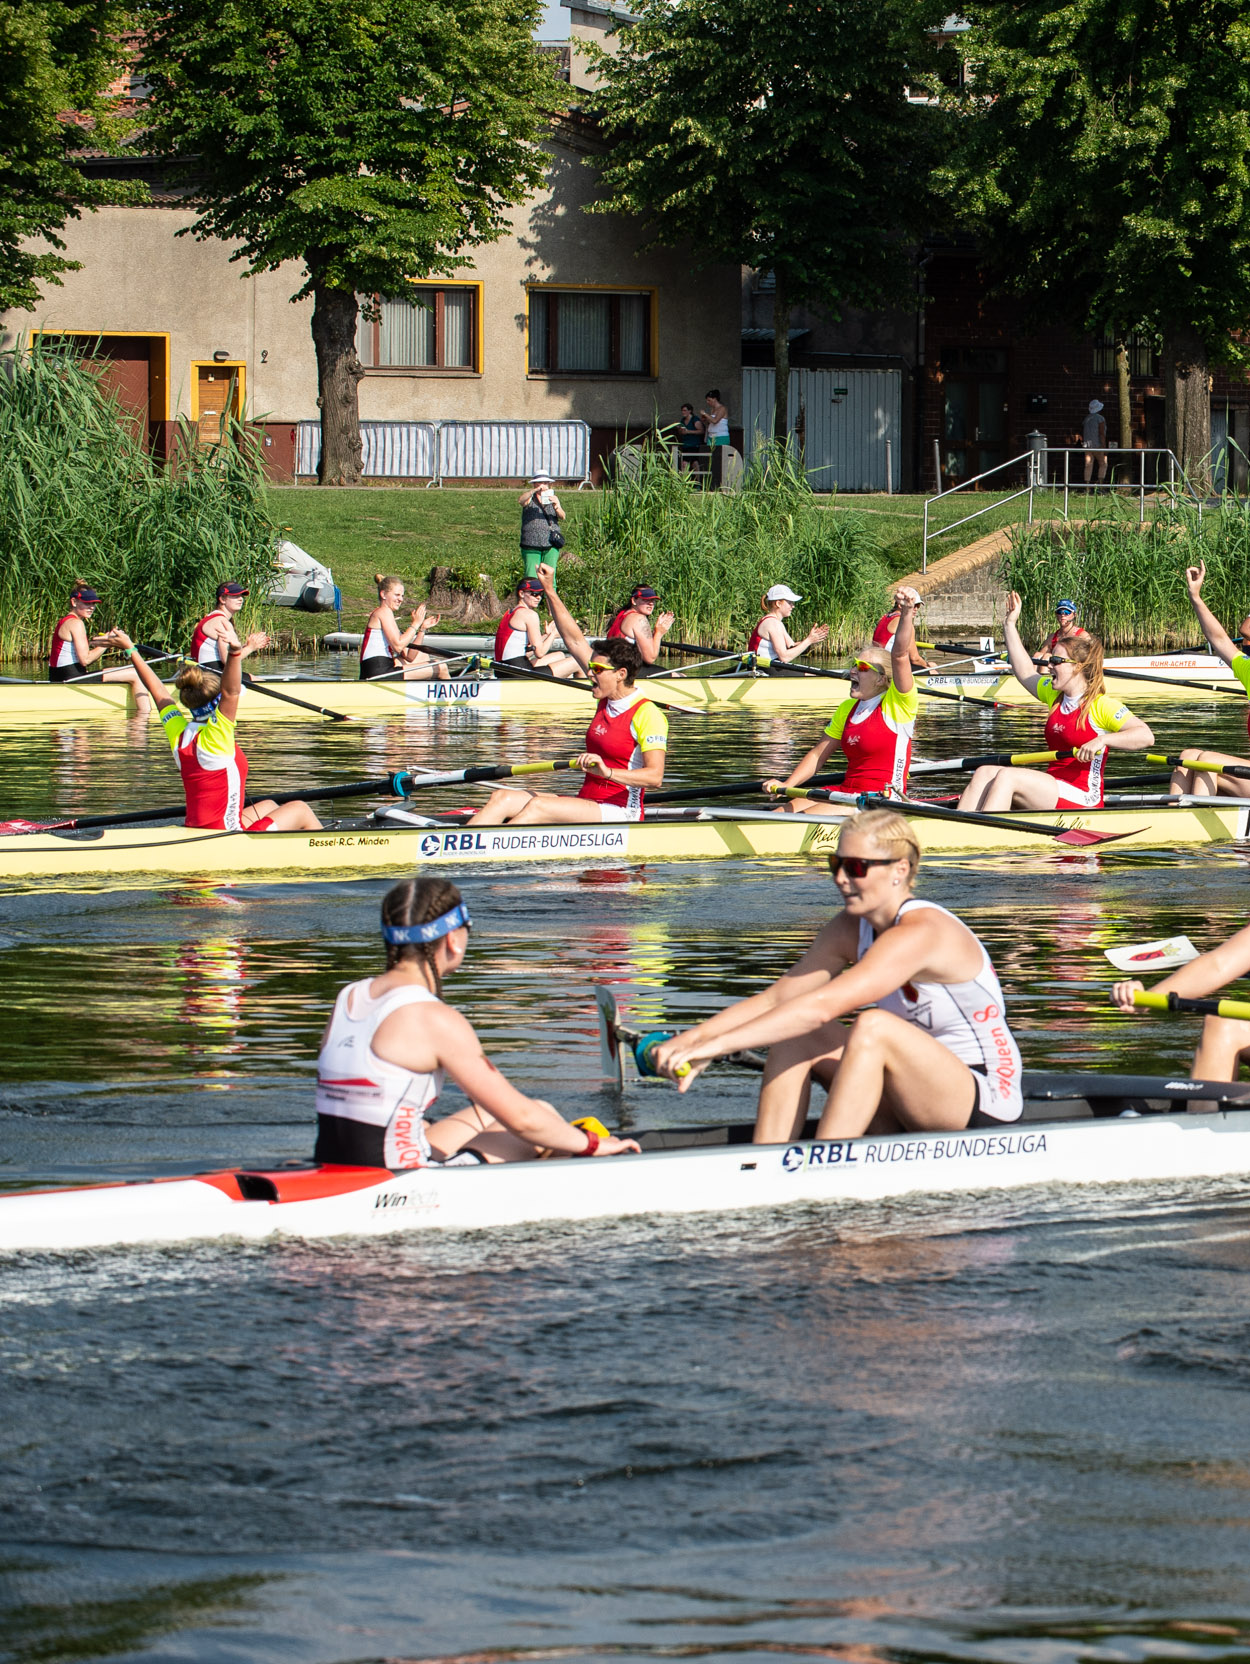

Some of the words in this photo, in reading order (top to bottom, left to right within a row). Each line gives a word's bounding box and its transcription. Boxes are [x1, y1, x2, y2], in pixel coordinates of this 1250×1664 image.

[1150, 660, 1197, 668] RUHR-ACHTER
[427, 683, 480, 699] HANAU
[357, 837, 389, 846] Minden
[443, 833, 487, 851] RBL
[492, 832, 624, 850] RUDER-BUNDESLIGA
[393, 929, 411, 941] NK
[420, 923, 440, 940] NK
[973, 1004, 1000, 1023] 8
[808, 1141, 858, 1164] RBL
[864, 1134, 1048, 1163] RUDER-BUNDESLIGA
